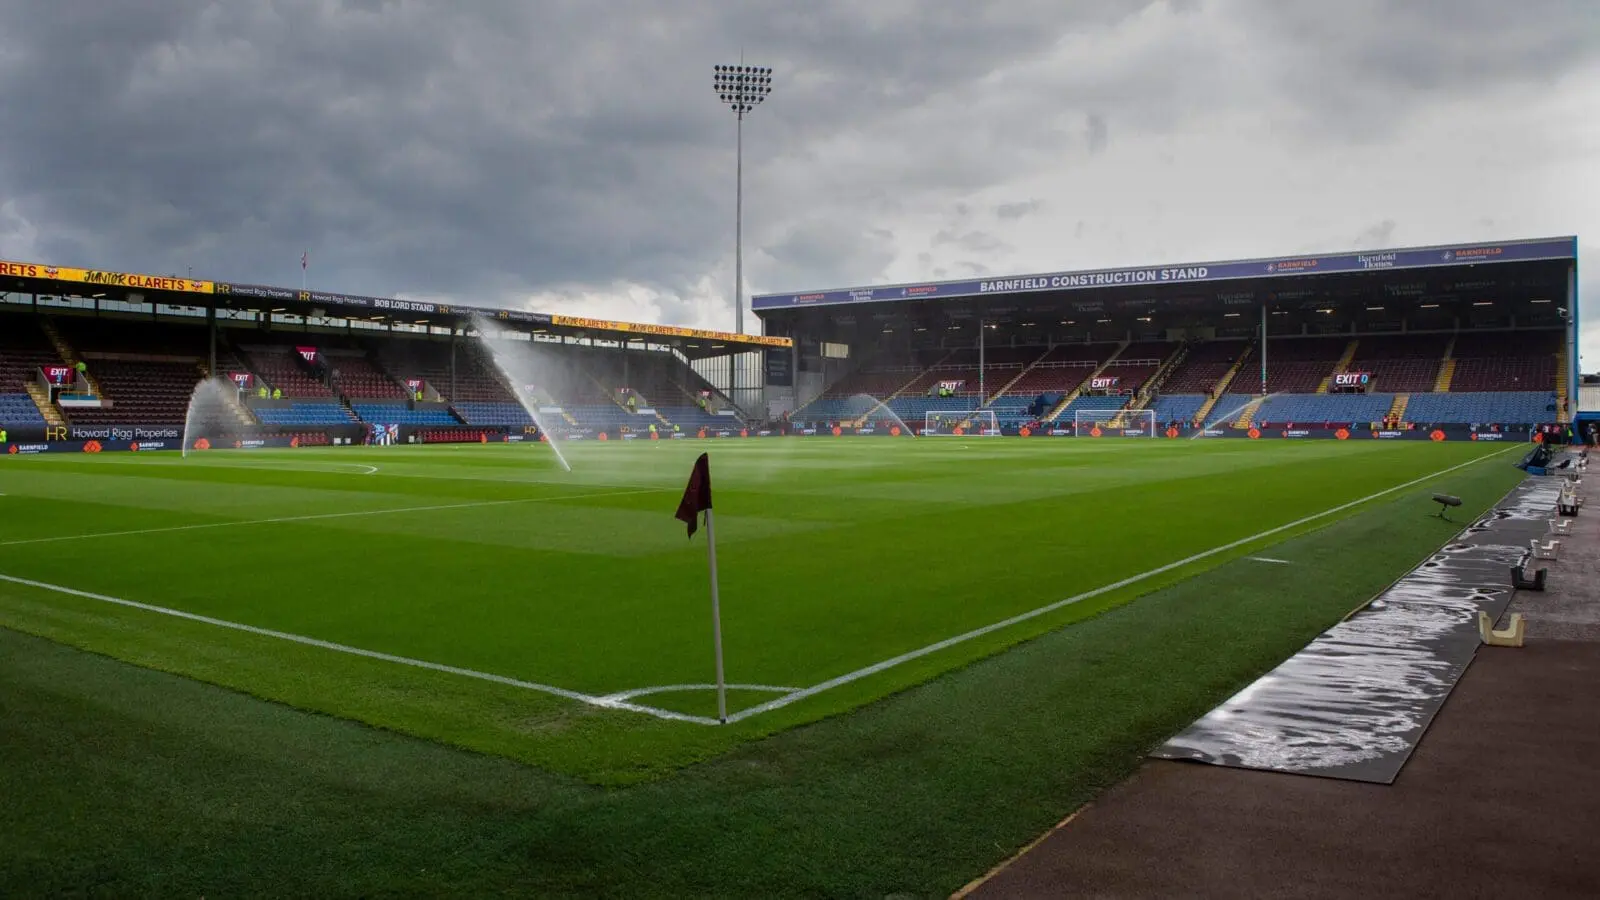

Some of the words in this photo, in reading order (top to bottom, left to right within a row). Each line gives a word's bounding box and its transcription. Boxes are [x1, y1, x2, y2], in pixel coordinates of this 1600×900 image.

[0, 263, 37, 277] RETS
[84, 270, 126, 285] JUNIOR
[127, 275, 185, 291] CLARETS
[980, 278, 1048, 293] BARNFIELD
[1051, 270, 1156, 288] CONSTRUCTION
[1160, 267, 1208, 281] STAND
[217, 284, 230, 294] HR
[299, 291, 310, 301] HR
[374, 299, 390, 308] BOB
[390, 301, 410, 311] LORD
[410, 304, 435, 313] STAND
[439, 305, 449, 314] HR
[499, 311, 509, 320] HR
[50, 368, 69, 377] EXIT
[235, 374, 249, 382] EXIT
[1091, 378, 1111, 388] EXIT
[1335, 374, 1359, 384] EXIT
[46, 426, 67, 441] HR
[72, 428, 110, 439] Howard
[112, 428, 133, 441] Rigg
[135, 428, 178, 441] Properties
